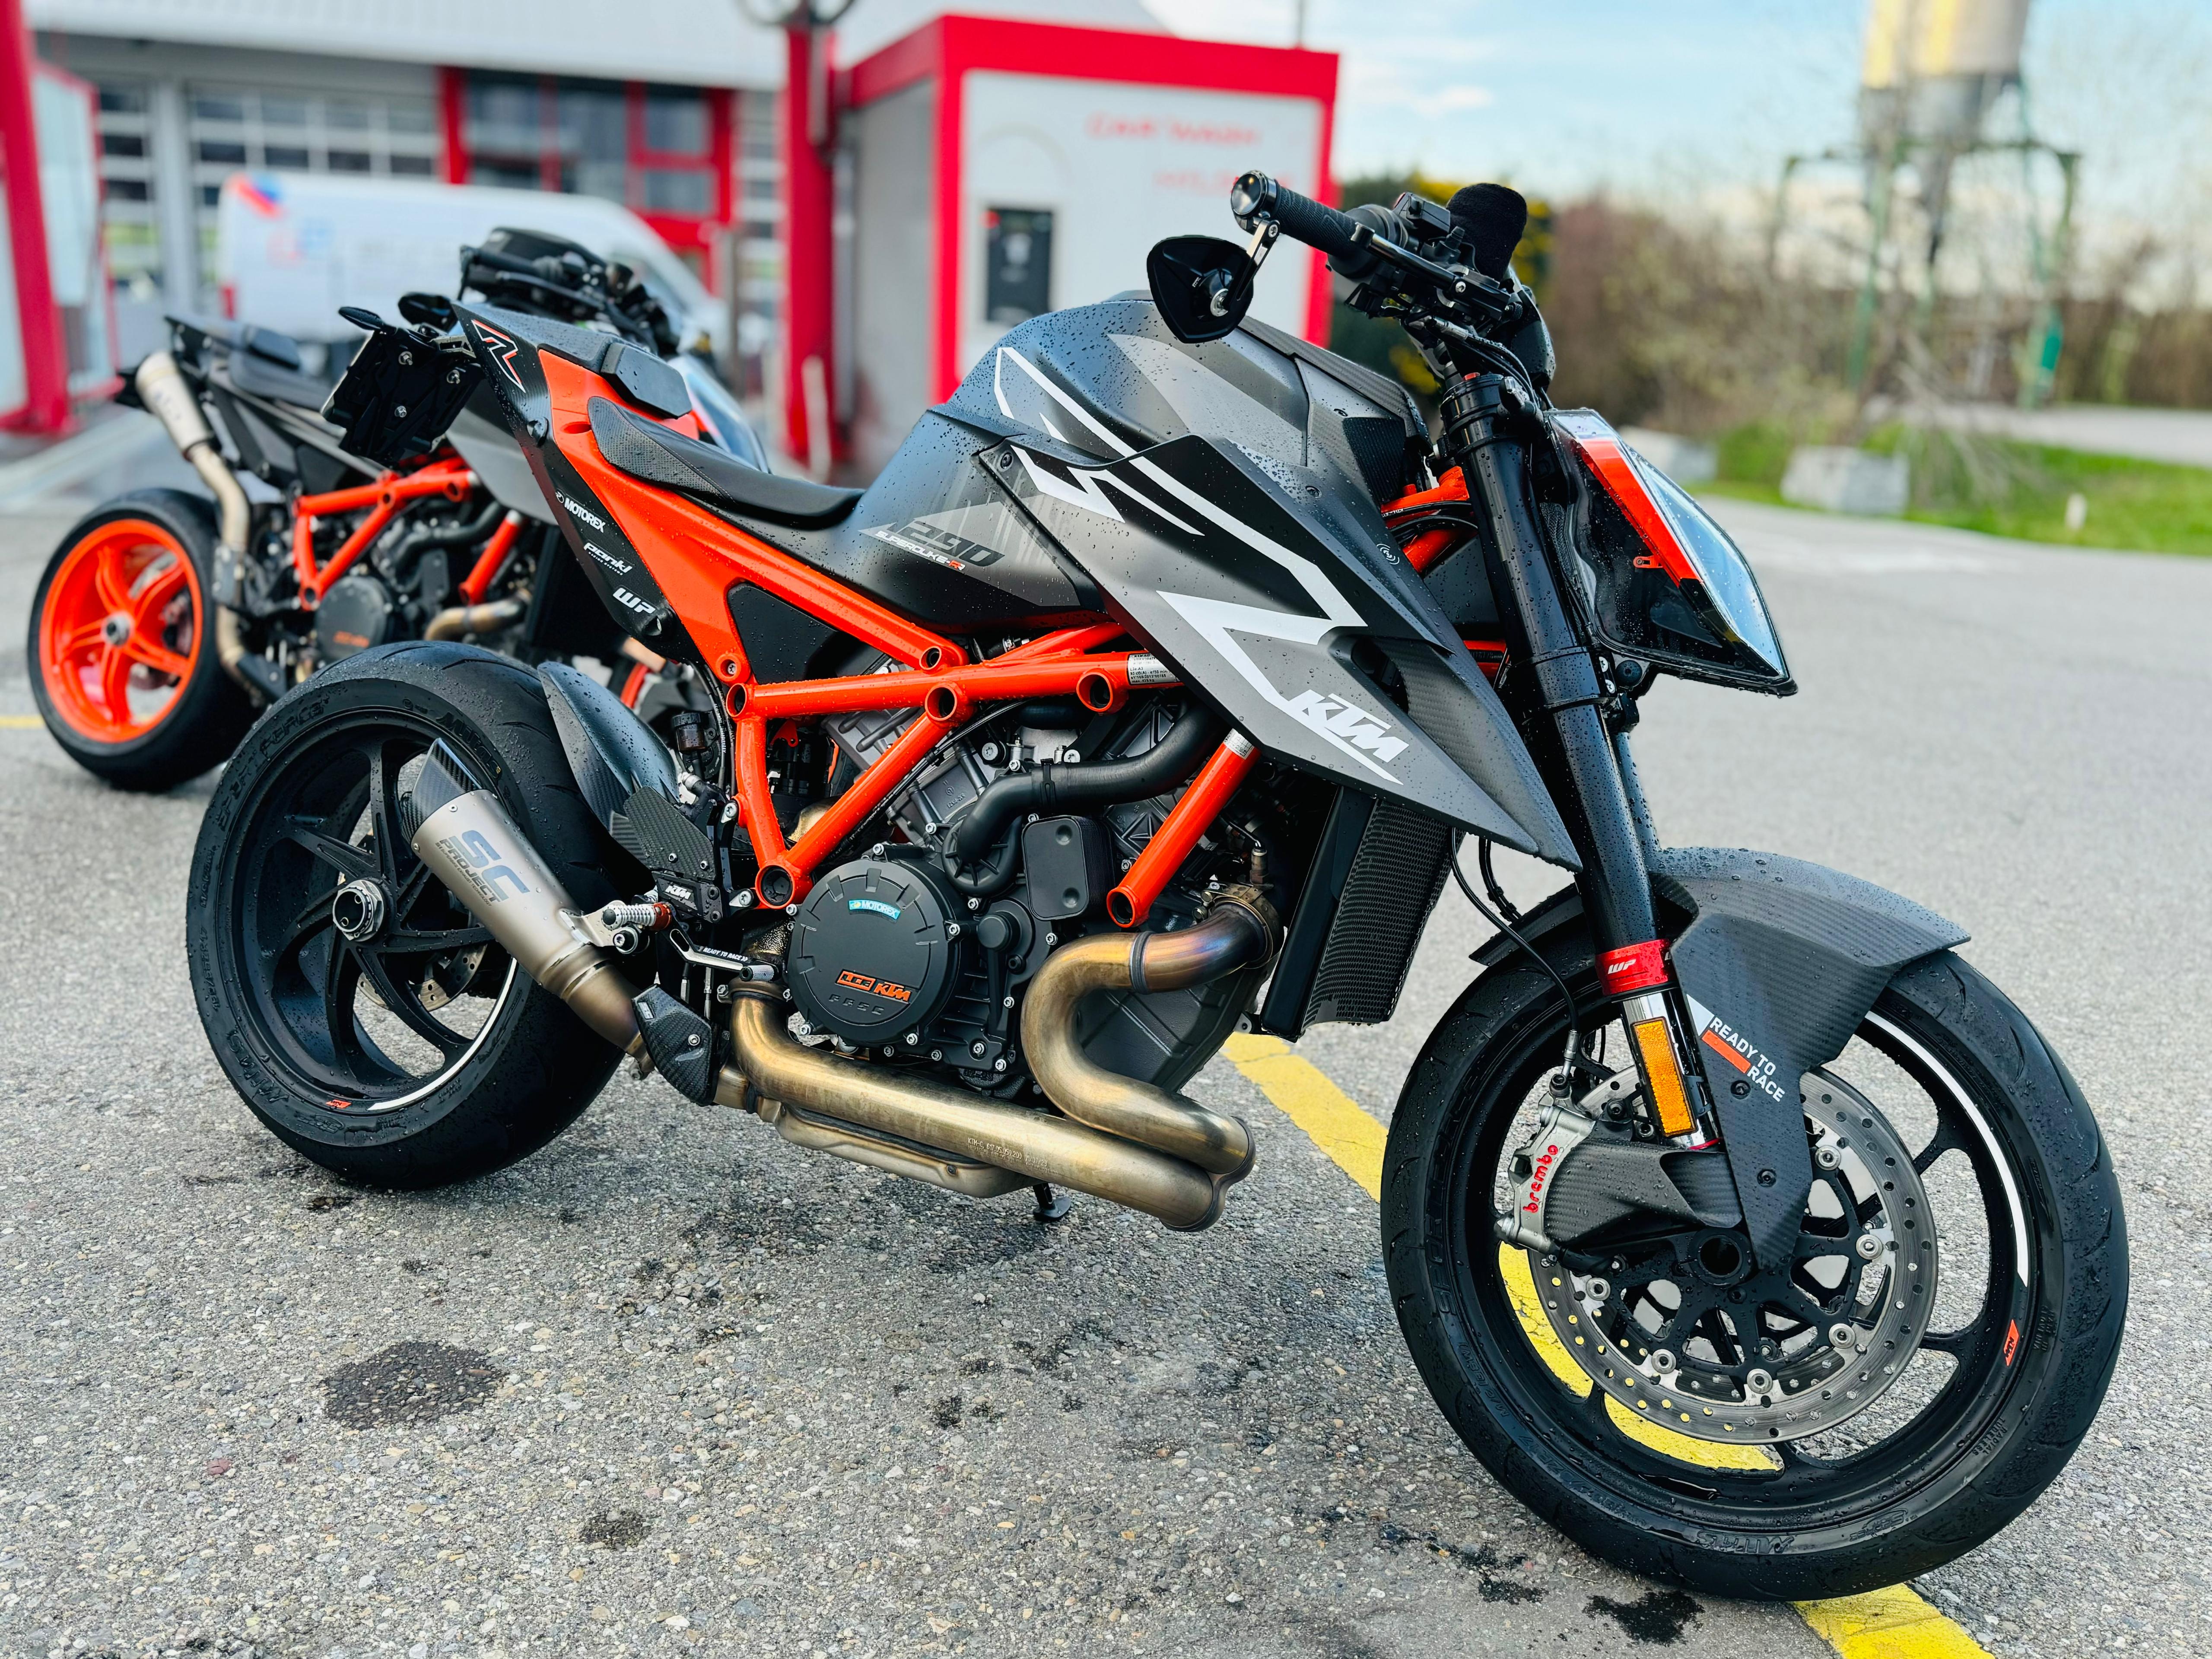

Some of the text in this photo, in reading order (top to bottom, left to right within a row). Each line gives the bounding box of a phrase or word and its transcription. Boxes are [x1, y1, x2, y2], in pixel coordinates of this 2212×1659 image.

[564, 498, 606, 533] MOTOREX
[887, 520, 1005, 567] 1290
[613, 587, 656, 614] WP
[1289, 689, 1409, 763] KTM
[439, 839, 501, 903] PROJECT
[449, 830, 531, 901] SC
[471, 883, 492, 906] TECHNOLOGY
[665, 885, 691, 899] KTM
[862, 900, 899, 919] MOTOREX
[1608, 959, 1636, 975] WP
[873, 982, 911, 1001] KTM
[1709, 1017, 1777, 1076] READY TO
[1747, 1065, 1785, 1102] RACE
[1522, 1144, 1558, 1214] brembo
[1971, 1417, 2006, 1456] TUBELESS
[1983, 1426, 2008, 1454] RADIAL
